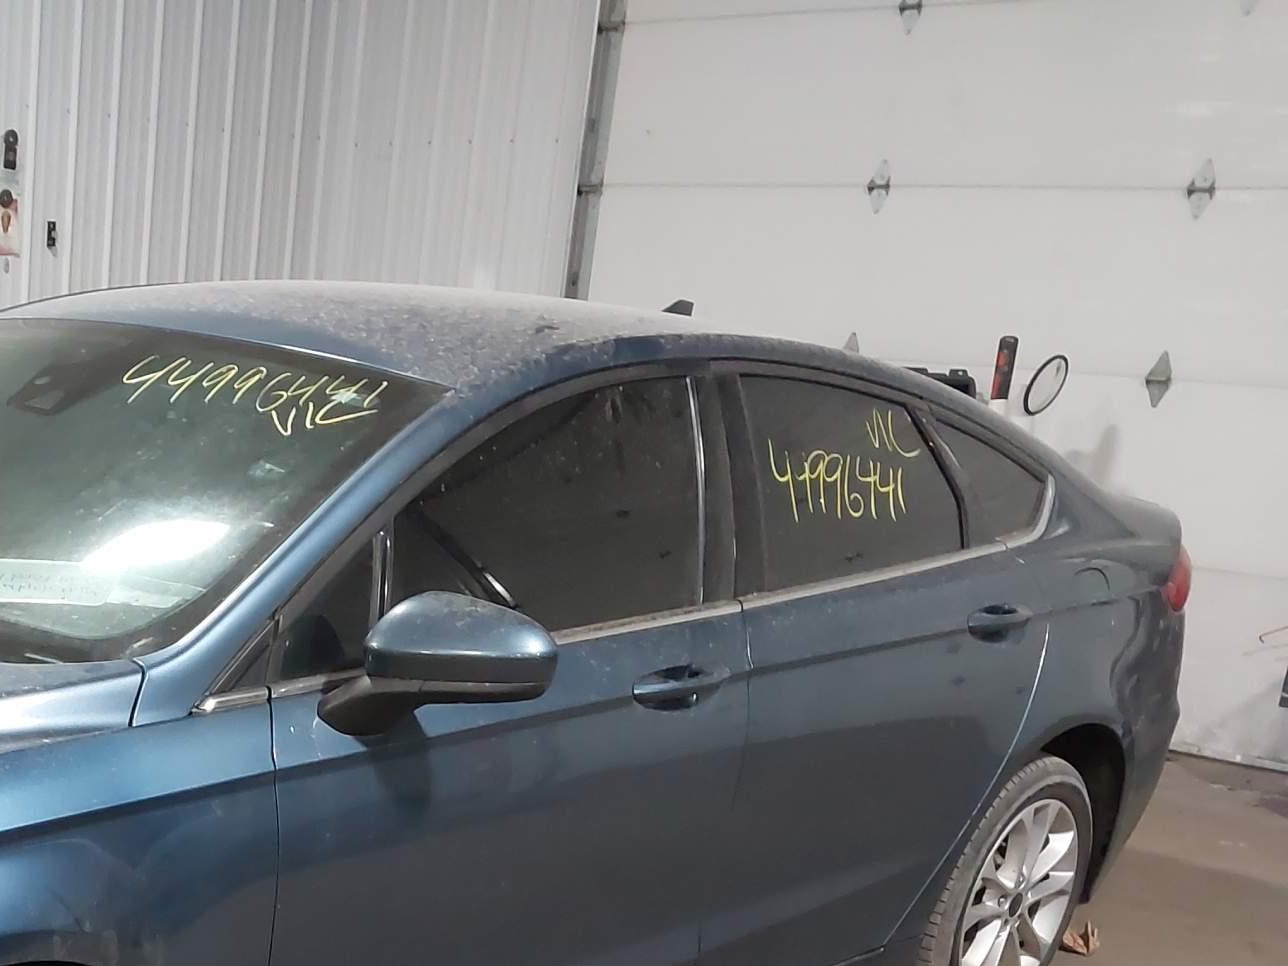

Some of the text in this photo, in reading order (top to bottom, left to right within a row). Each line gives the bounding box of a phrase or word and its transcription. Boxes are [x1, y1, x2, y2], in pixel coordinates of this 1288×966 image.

[122, 354, 389, 412] 44996441
[272, 401, 379, 436] VIC
[768, 437, 907, 523] 44996441
